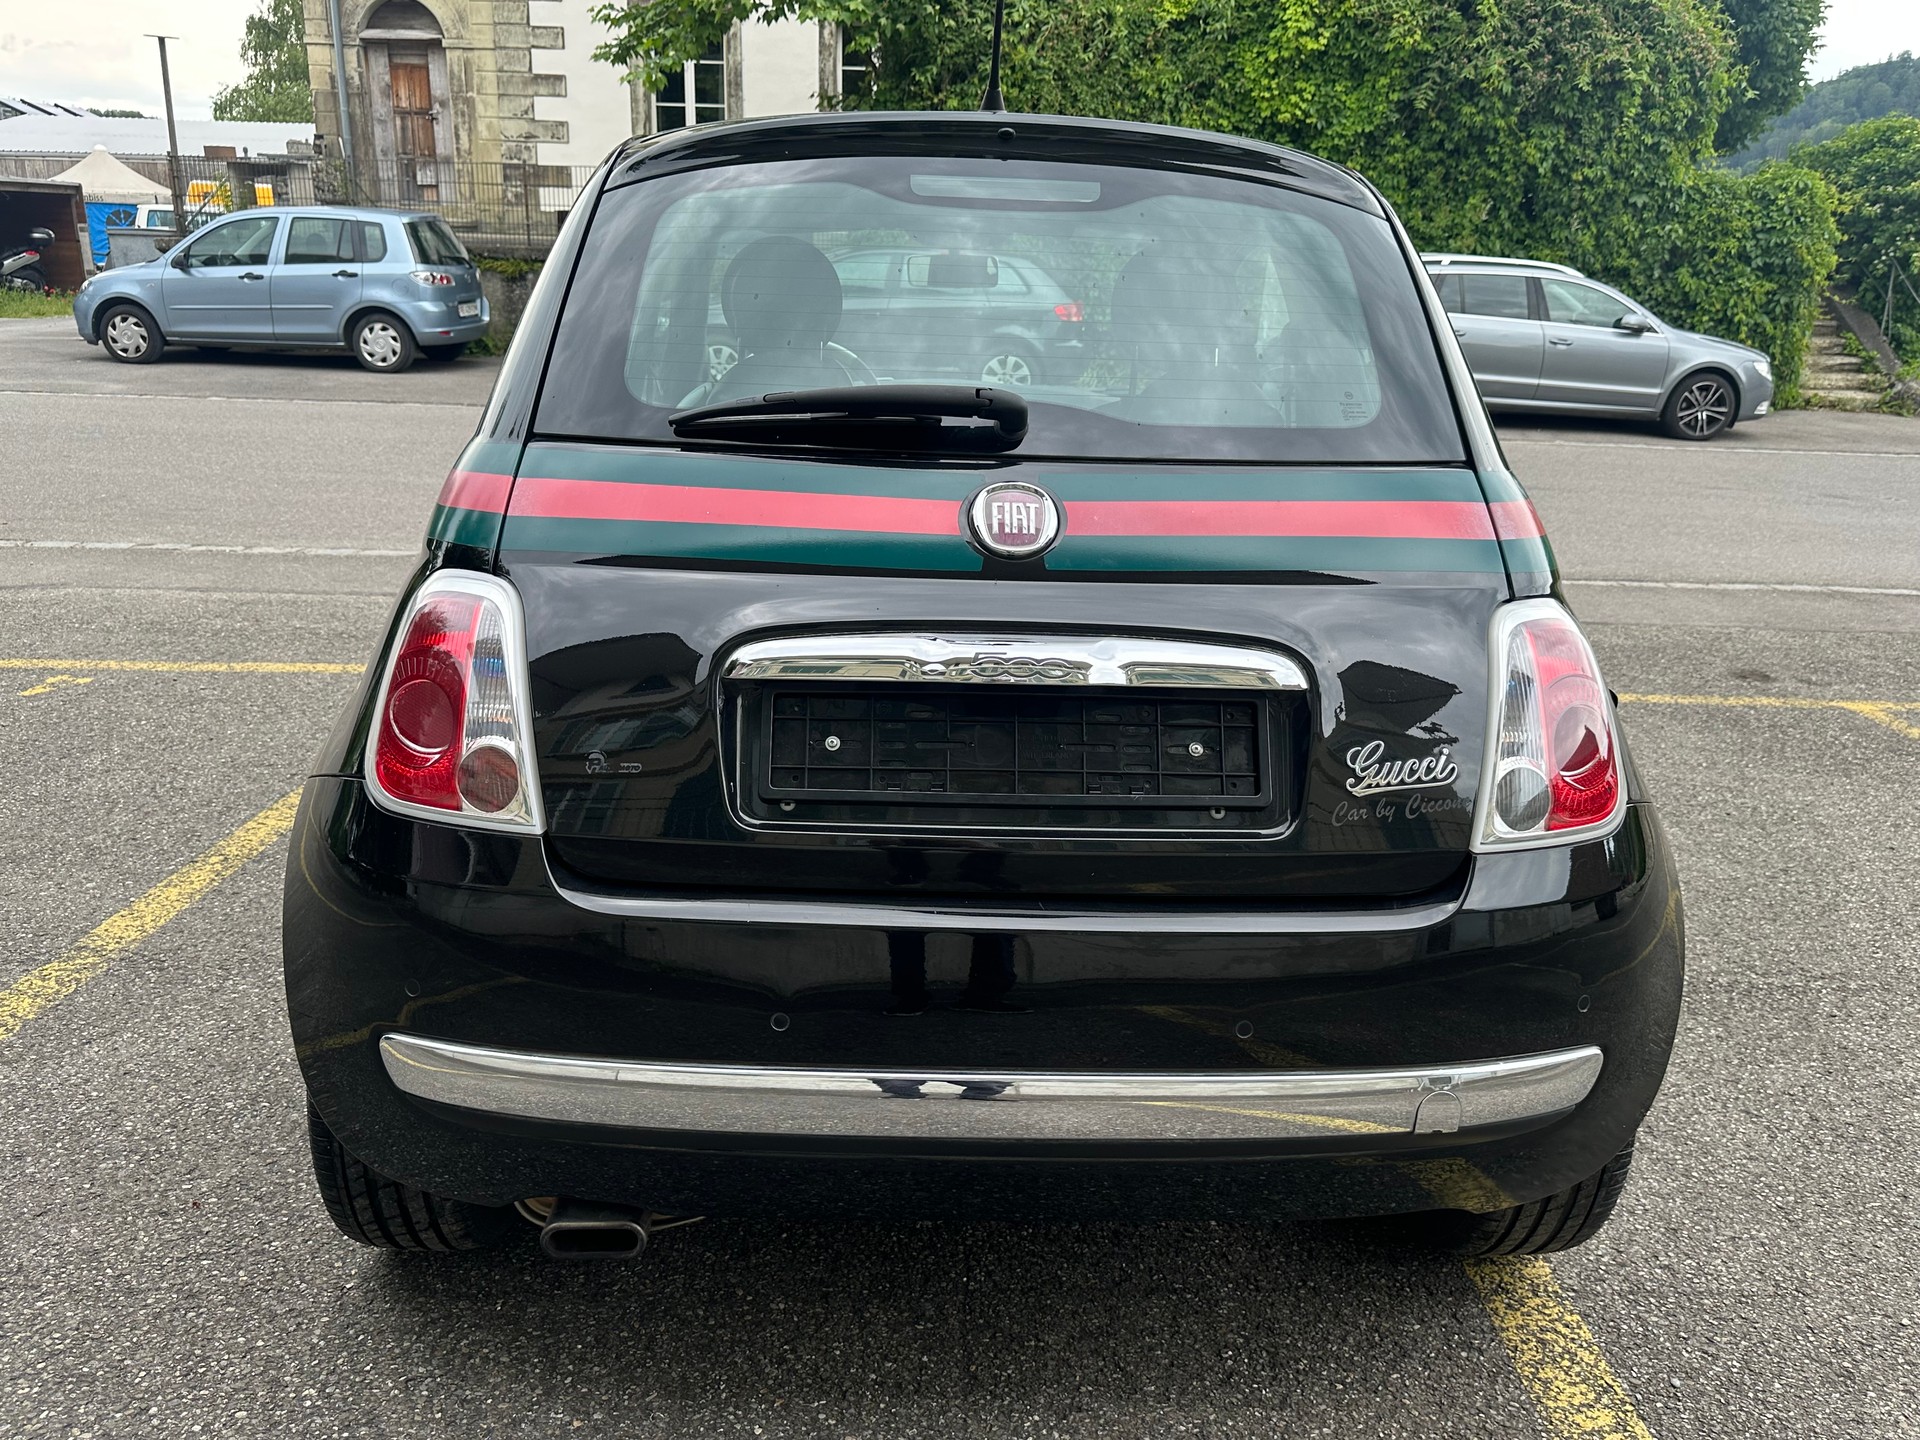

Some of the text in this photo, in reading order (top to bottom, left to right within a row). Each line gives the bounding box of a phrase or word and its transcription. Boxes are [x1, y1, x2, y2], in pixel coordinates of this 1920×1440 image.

[991, 501, 1039, 535] FIAT
[969, 652, 1073, 679] 500
[1346, 740, 1458, 797] Gucci
[1331, 801, 1368, 827] Car
[1375, 798, 1396, 822] by
